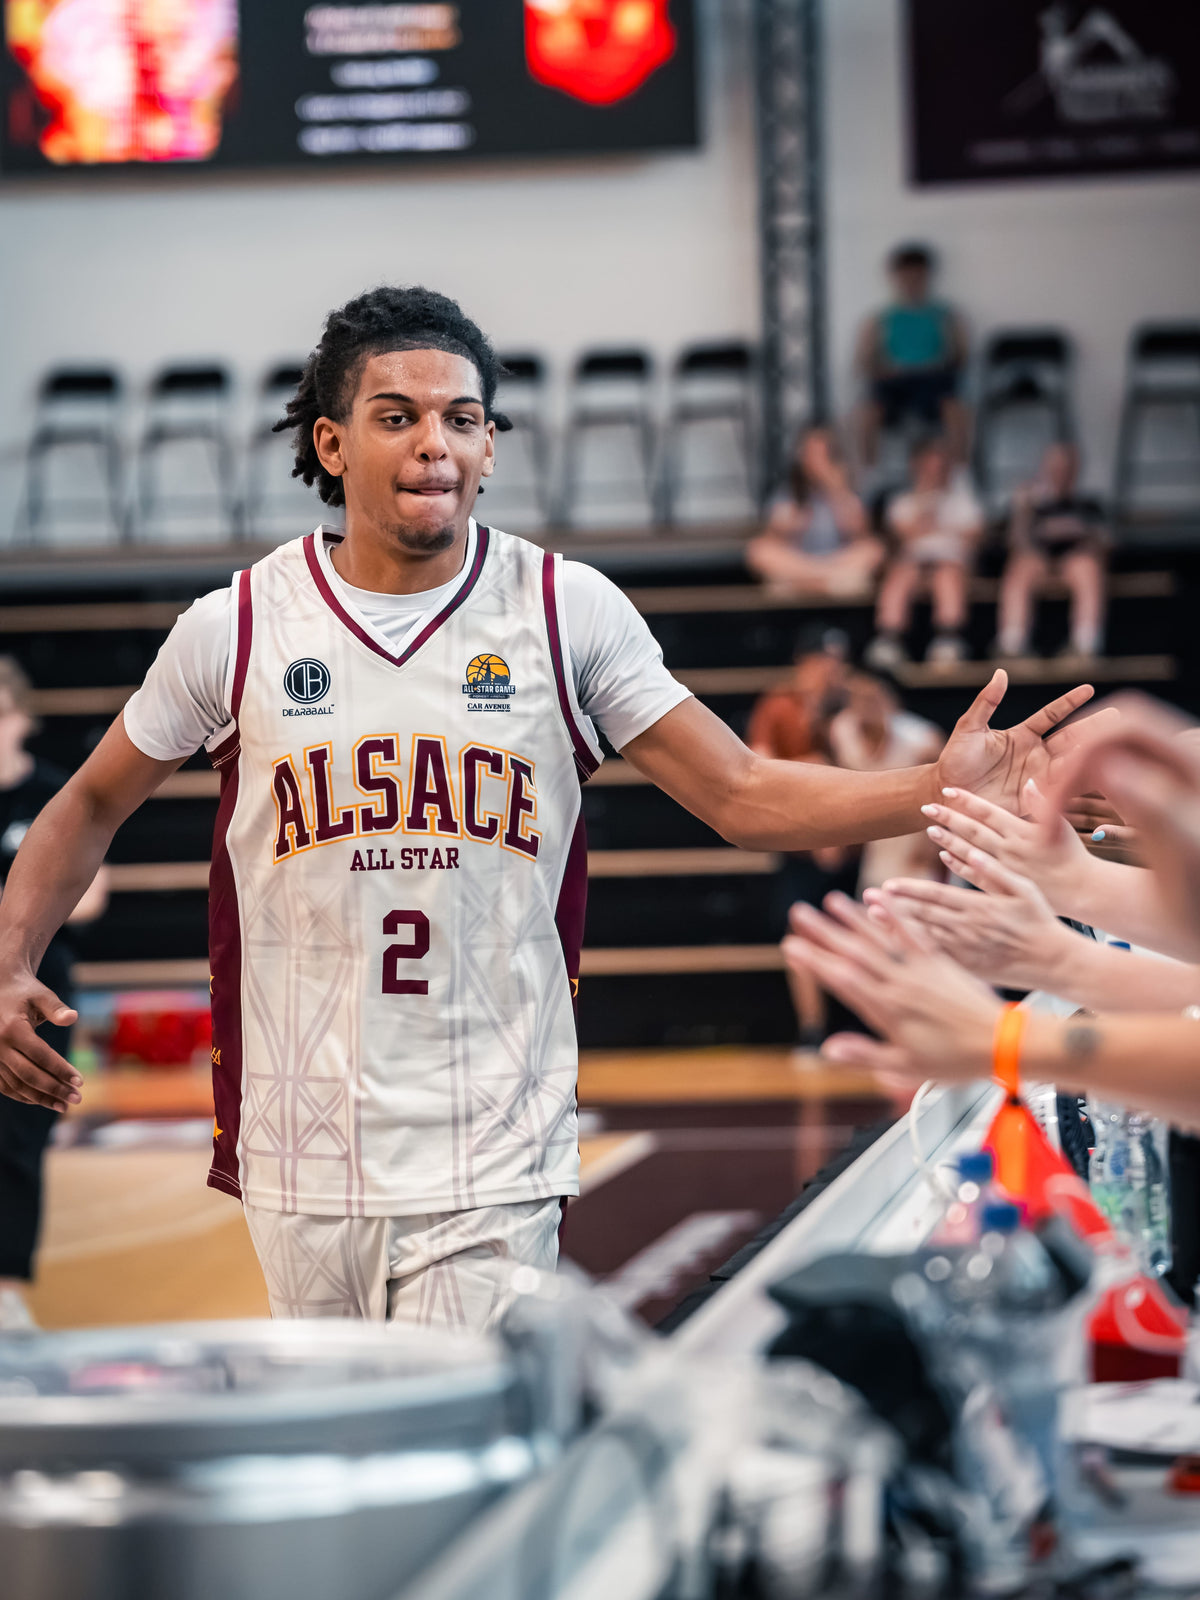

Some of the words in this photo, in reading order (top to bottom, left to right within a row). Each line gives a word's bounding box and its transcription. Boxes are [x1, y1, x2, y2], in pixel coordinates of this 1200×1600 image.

[463, 685, 475, 693] ALL
[476, 685, 494, 693] STAR
[494, 685, 515, 694] GAME
[282, 707, 334, 717] DEARBBALL
[271, 733, 543, 865] ALSACE
[350, 849, 394, 871] ALL
[400, 847, 460, 870] STAR
[381, 909, 430, 995] 2
